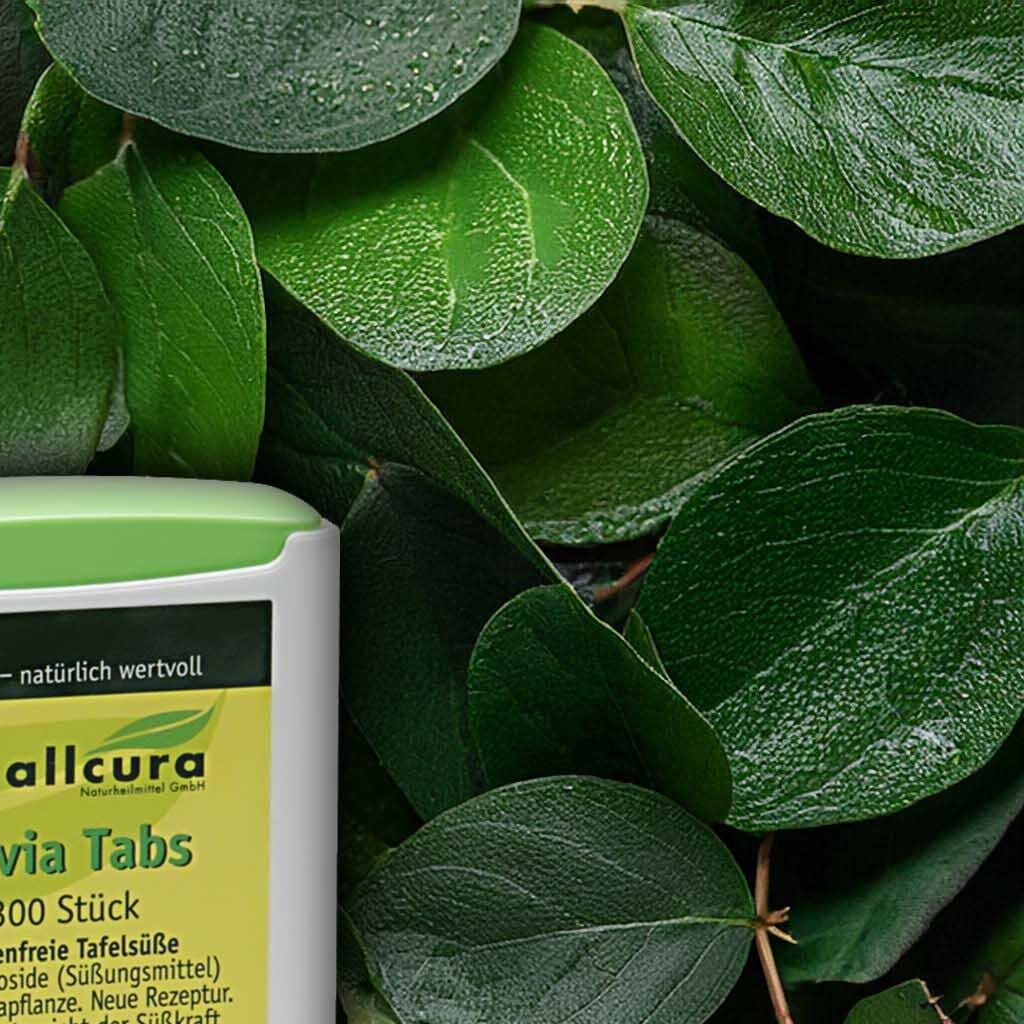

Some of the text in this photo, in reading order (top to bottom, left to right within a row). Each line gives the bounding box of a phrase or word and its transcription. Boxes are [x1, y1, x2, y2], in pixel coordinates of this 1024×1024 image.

[20, 660, 112, 685] natürlich
[119, 655, 203, 680] wertvoll
[5, 745, 205, 788] allcura
[80, 781, 206, 798] Naturheilmittel GmbH
[82, 823, 193, 872] Tabs
[57, 890, 140, 924] Stück
[77, 932, 180, 960] Tafelsüße
[57, 956, 221, 993] (Süßungsmittel)
[91, 990, 138, 1012] Neue
[146, 984, 233, 1012] Rezeptur.
